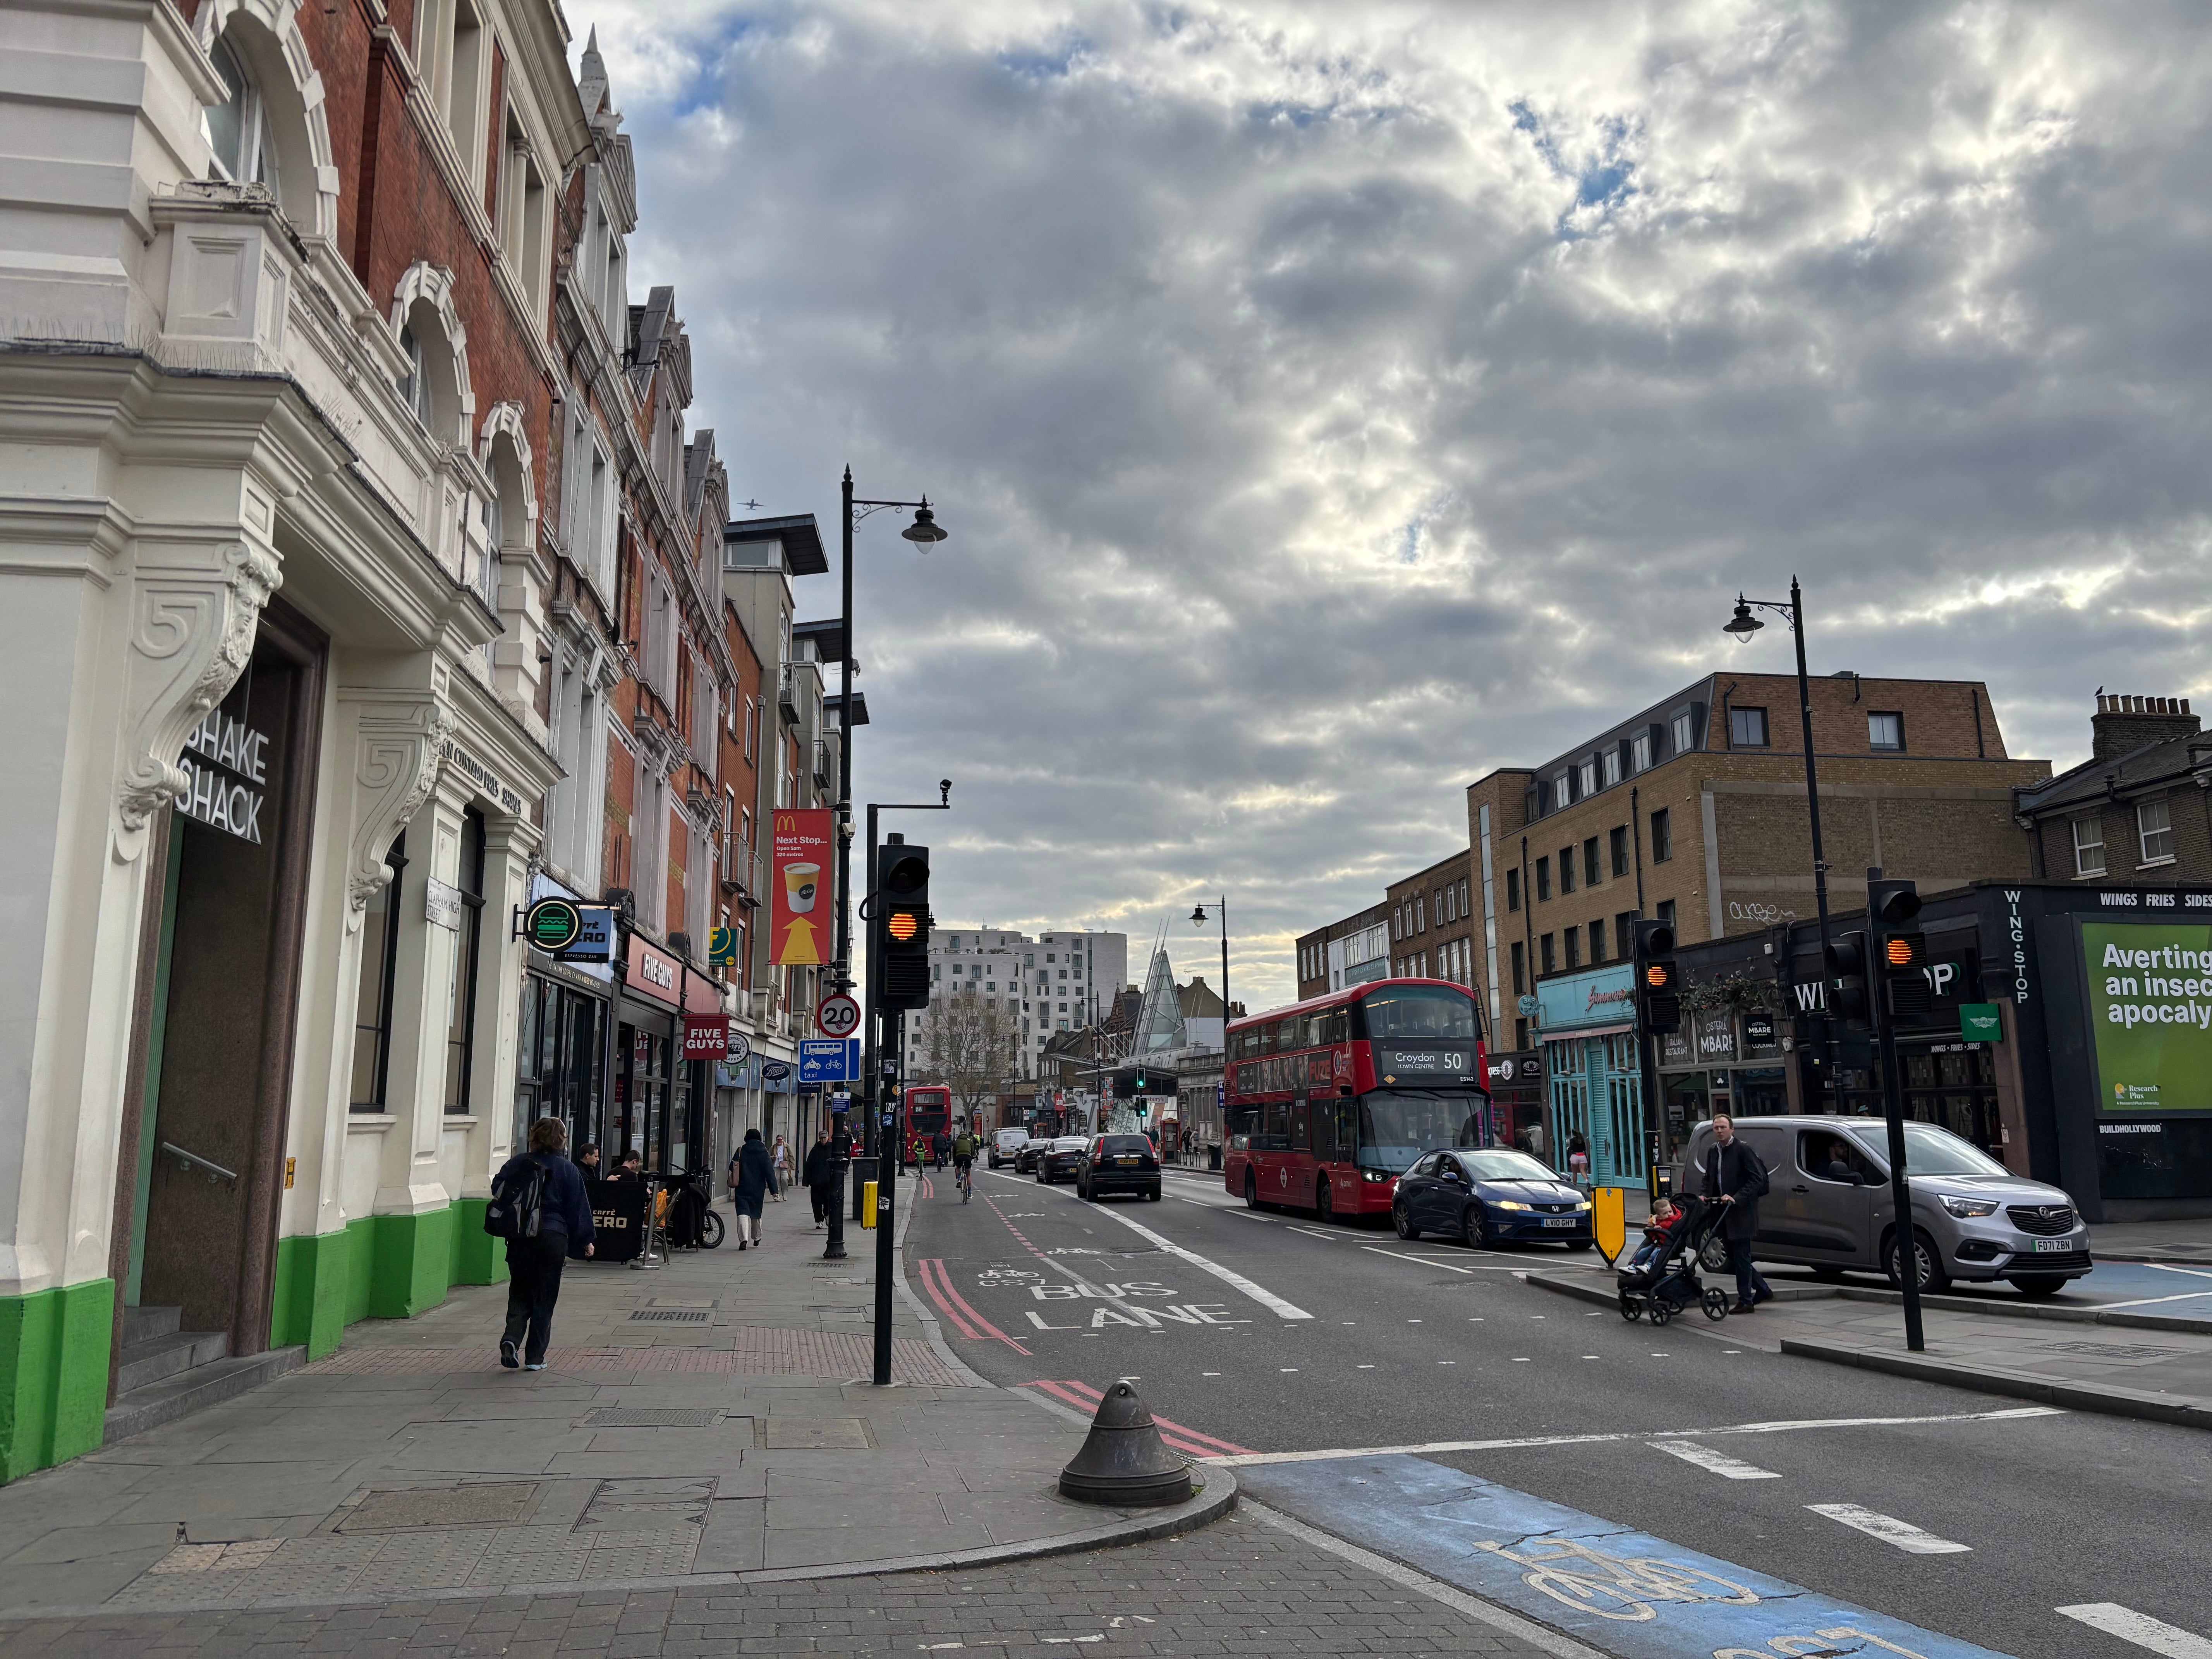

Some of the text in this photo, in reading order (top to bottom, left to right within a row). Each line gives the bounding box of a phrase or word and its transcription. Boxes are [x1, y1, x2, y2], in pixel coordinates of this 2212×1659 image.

[454, 748, 483, 783] CUSTARD
[484, 771, 499, 798] FRIES
[502, 787, 521, 814] SHAKES
[175, 758, 264, 845] SHACK
[799, 836, 827, 846] Stop...
[428, 890, 460, 915] CLAPHAM HIGH
[2100, 893, 2212, 907] WINGS FRIES SIDES
[427, 904, 441, 921] STREET
[2102, 944, 2212, 975] Averting
[644, 954, 672, 990] FIVE GUYS
[2106, 977, 2138, 996] an
[824, 1006, 854, 1025] 20
[2109, 1000, 2212, 1029] apocaly
[690, 1029, 721, 1038] FIVE
[1706, 1020, 1727, 1032] OSTERIA
[686, 1039, 725, 1049] GUYS
[1669, 1037, 1683, 1046] ITALIAN
[1931, 1045, 1946, 1053] WINGS
[1666, 1047, 1688, 1056] RESTAURANT
[1395, 1053, 1462, 1069] Croydon 50
[765, 1066, 786, 1077] Boots
[1309, 1060, 1331, 1082] FUZE
[592, 1216, 627, 1228] ERO
[2038, 1240, 2070, 1251] FD71 ZBN
[1028, 1282, 1178, 1300] BUS
[1025, 1304, 1252, 1330] LANE
